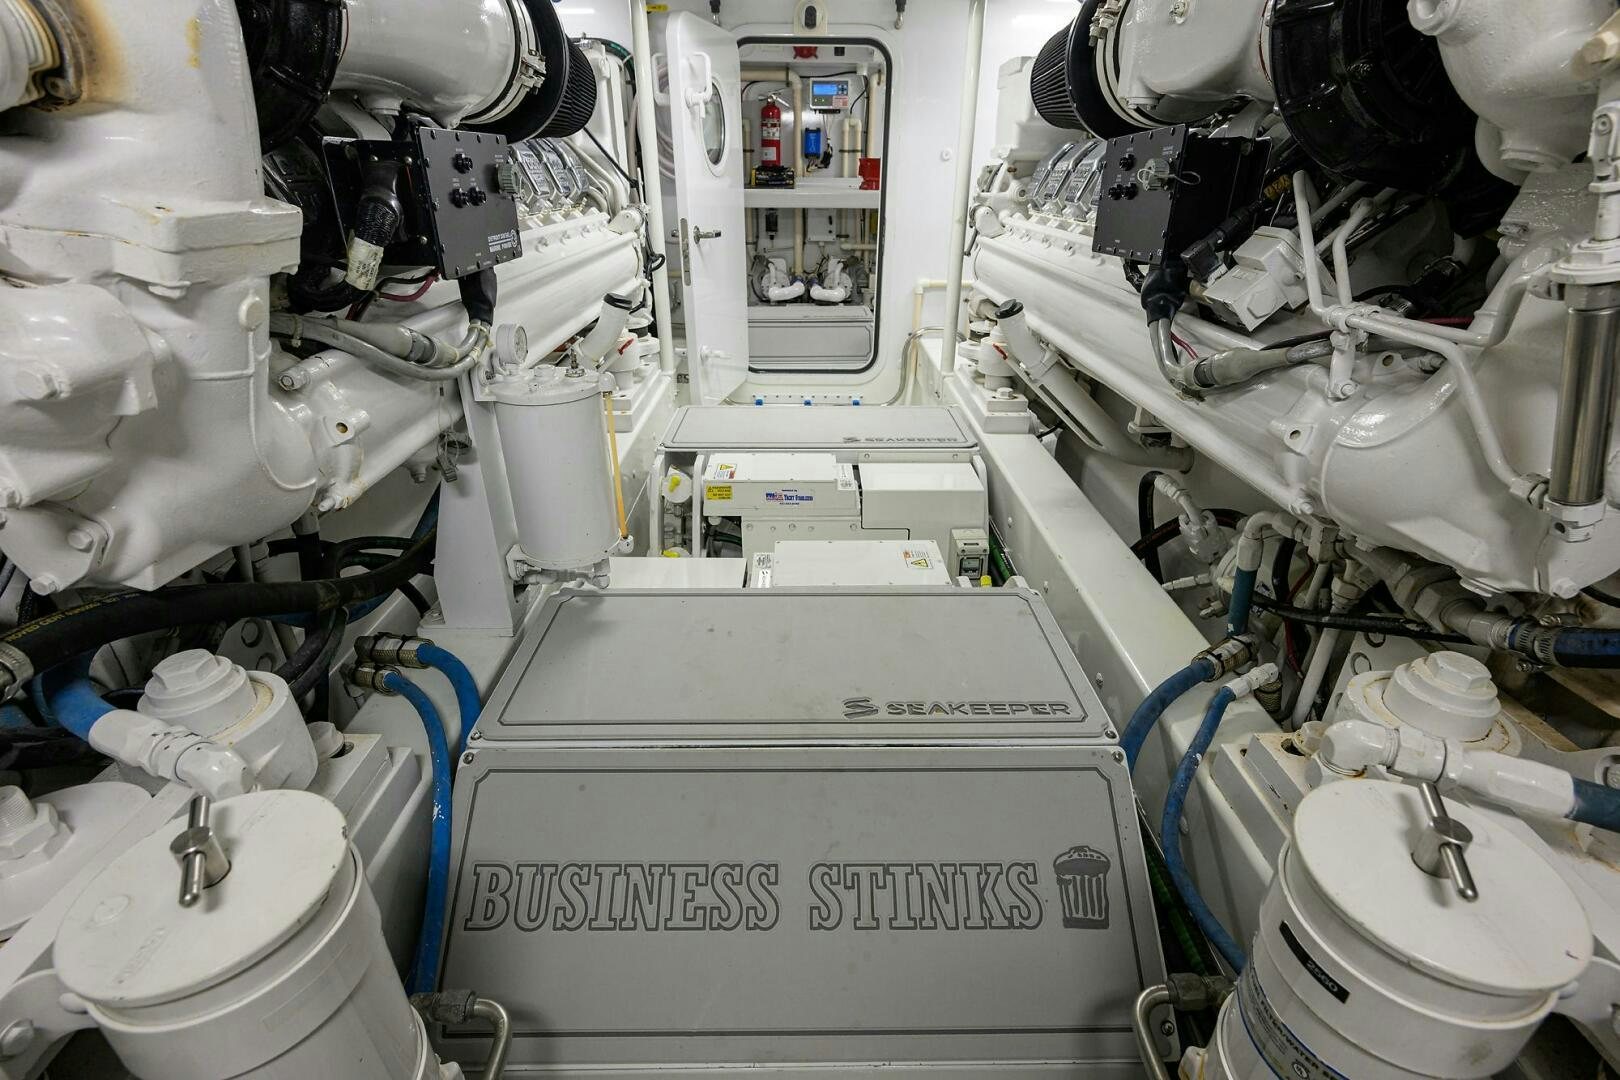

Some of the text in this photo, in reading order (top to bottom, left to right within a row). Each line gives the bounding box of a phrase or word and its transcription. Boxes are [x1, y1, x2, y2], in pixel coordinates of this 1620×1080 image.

[887, 703, 1071, 716] SEAKEEPER
[463, 863, 1044, 932] BUSINESS STINKS
